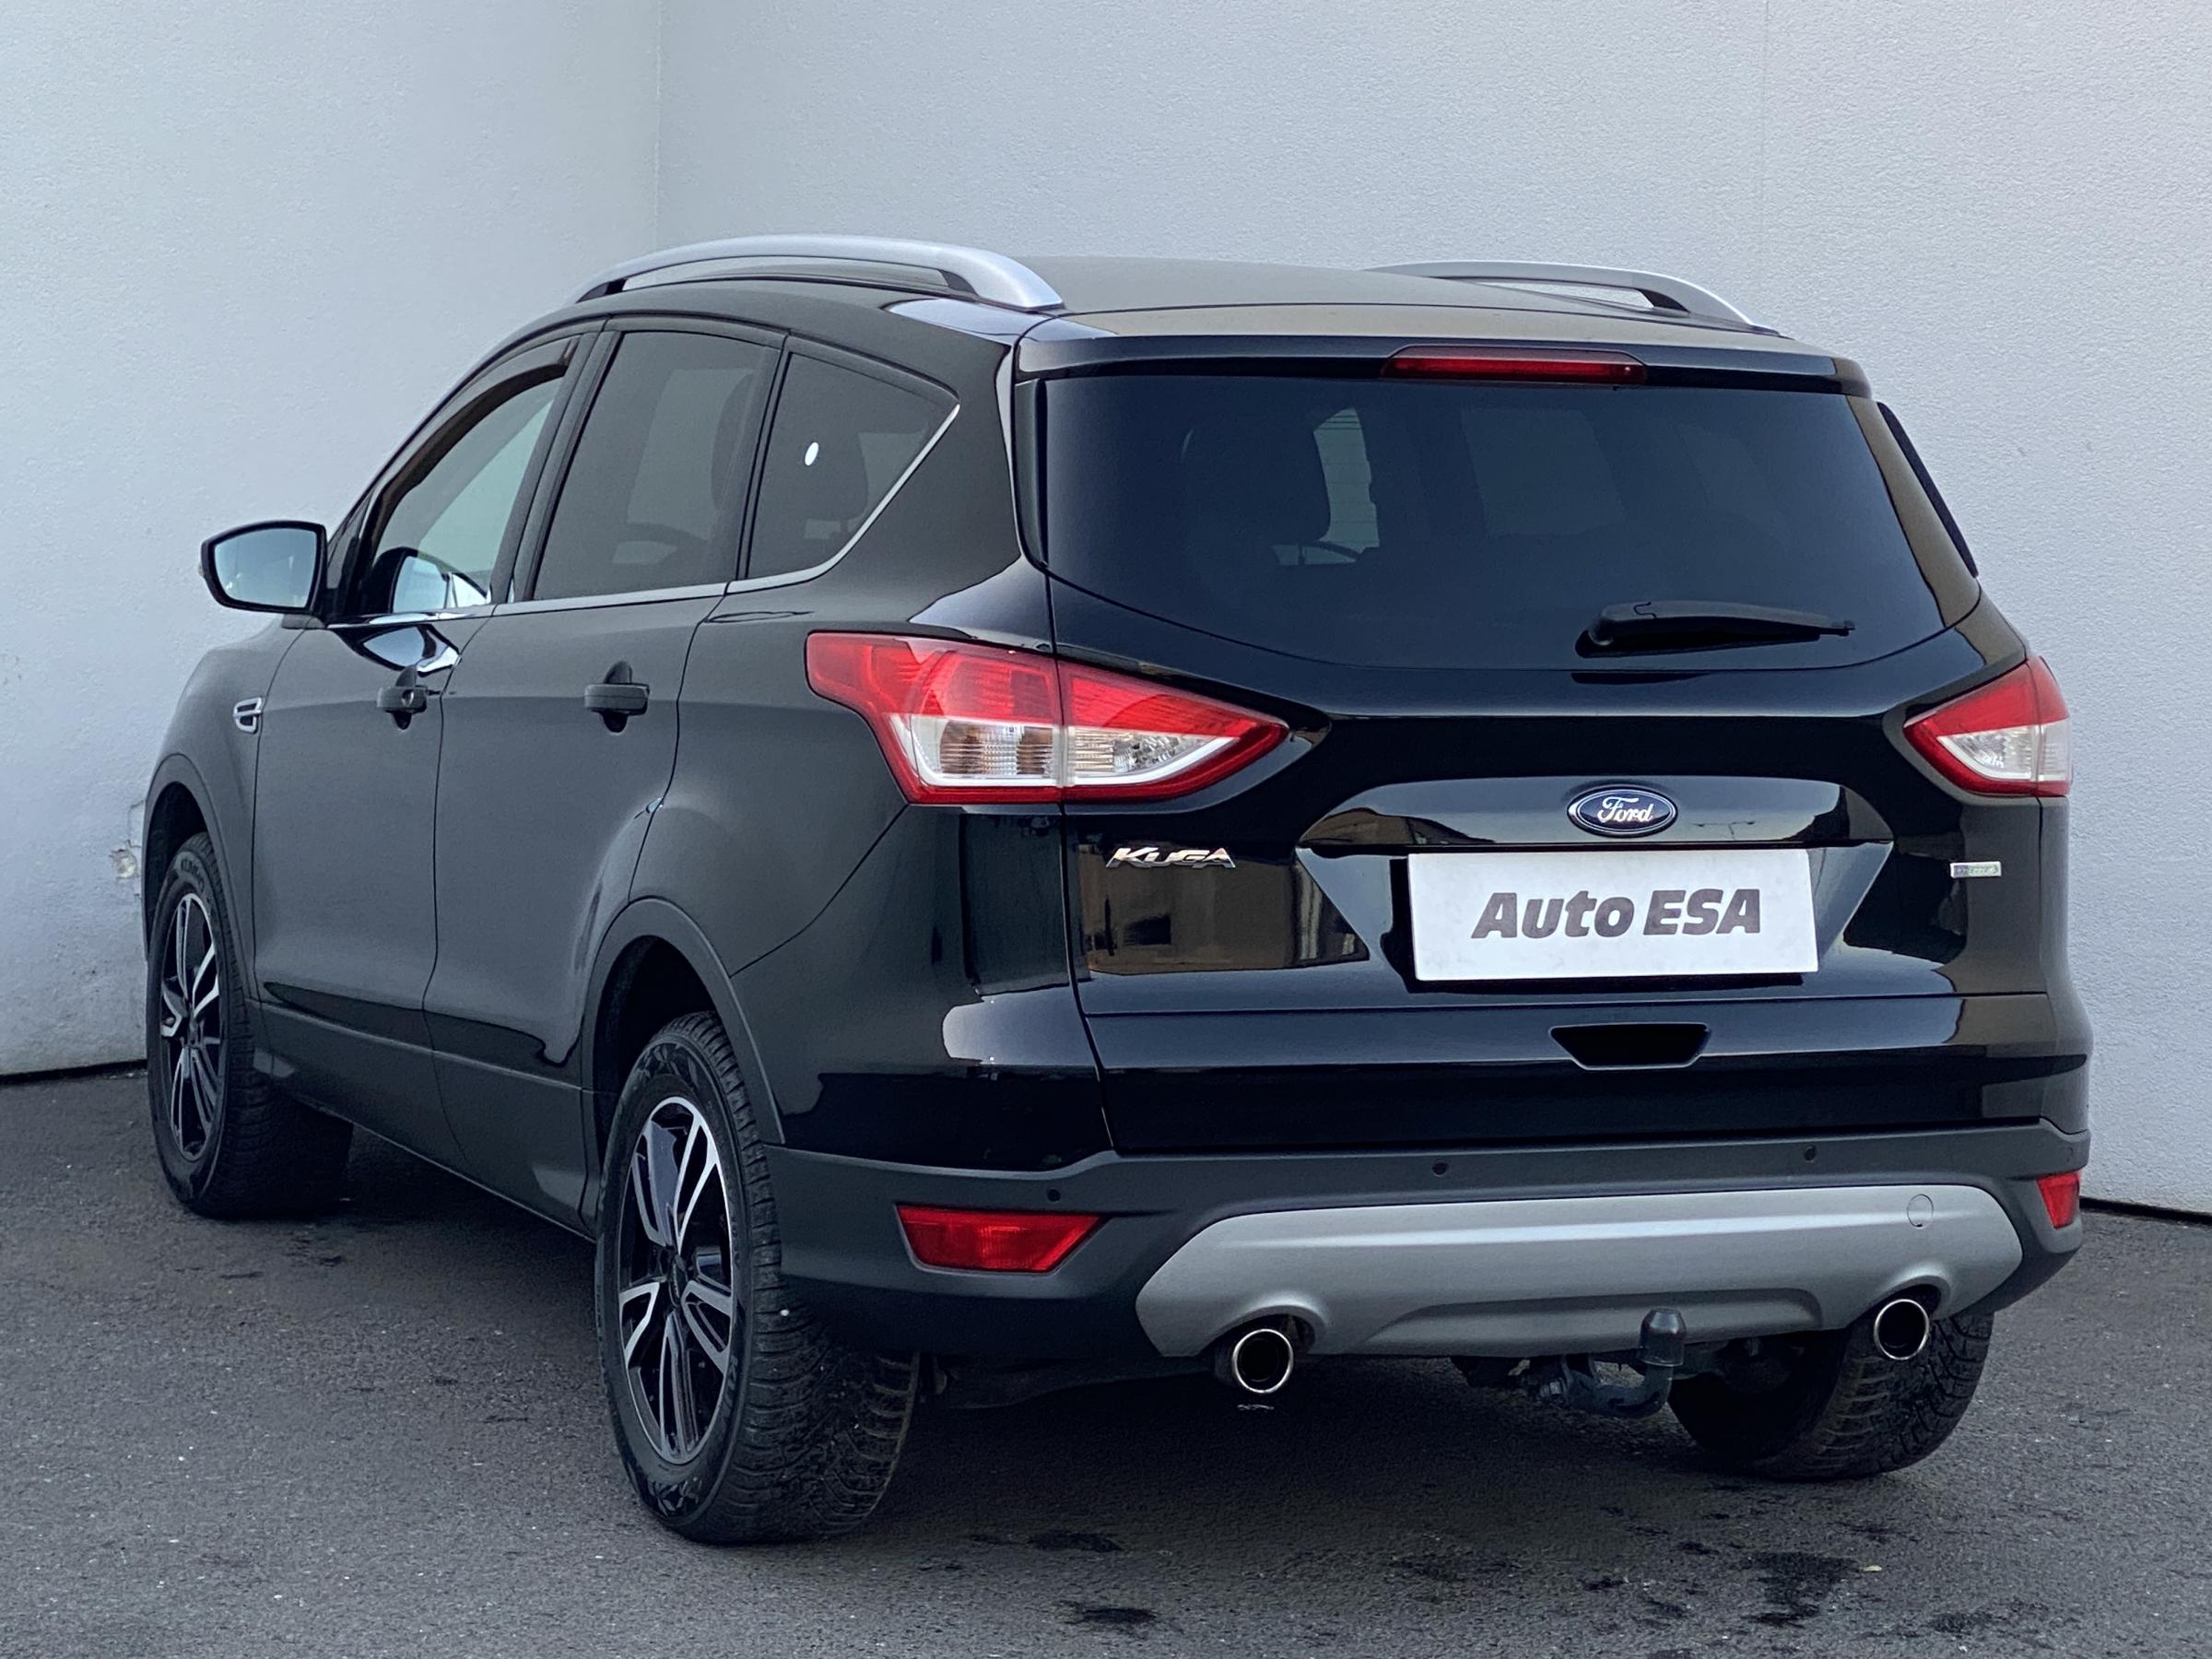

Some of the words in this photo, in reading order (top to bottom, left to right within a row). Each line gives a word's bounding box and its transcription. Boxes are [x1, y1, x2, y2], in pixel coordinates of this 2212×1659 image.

[1597, 796, 1654, 823] Ford
[1106, 846, 1236, 869] KUGA
[1471, 890, 1635, 939] Auto
[1643, 888, 1760, 935] ESA
